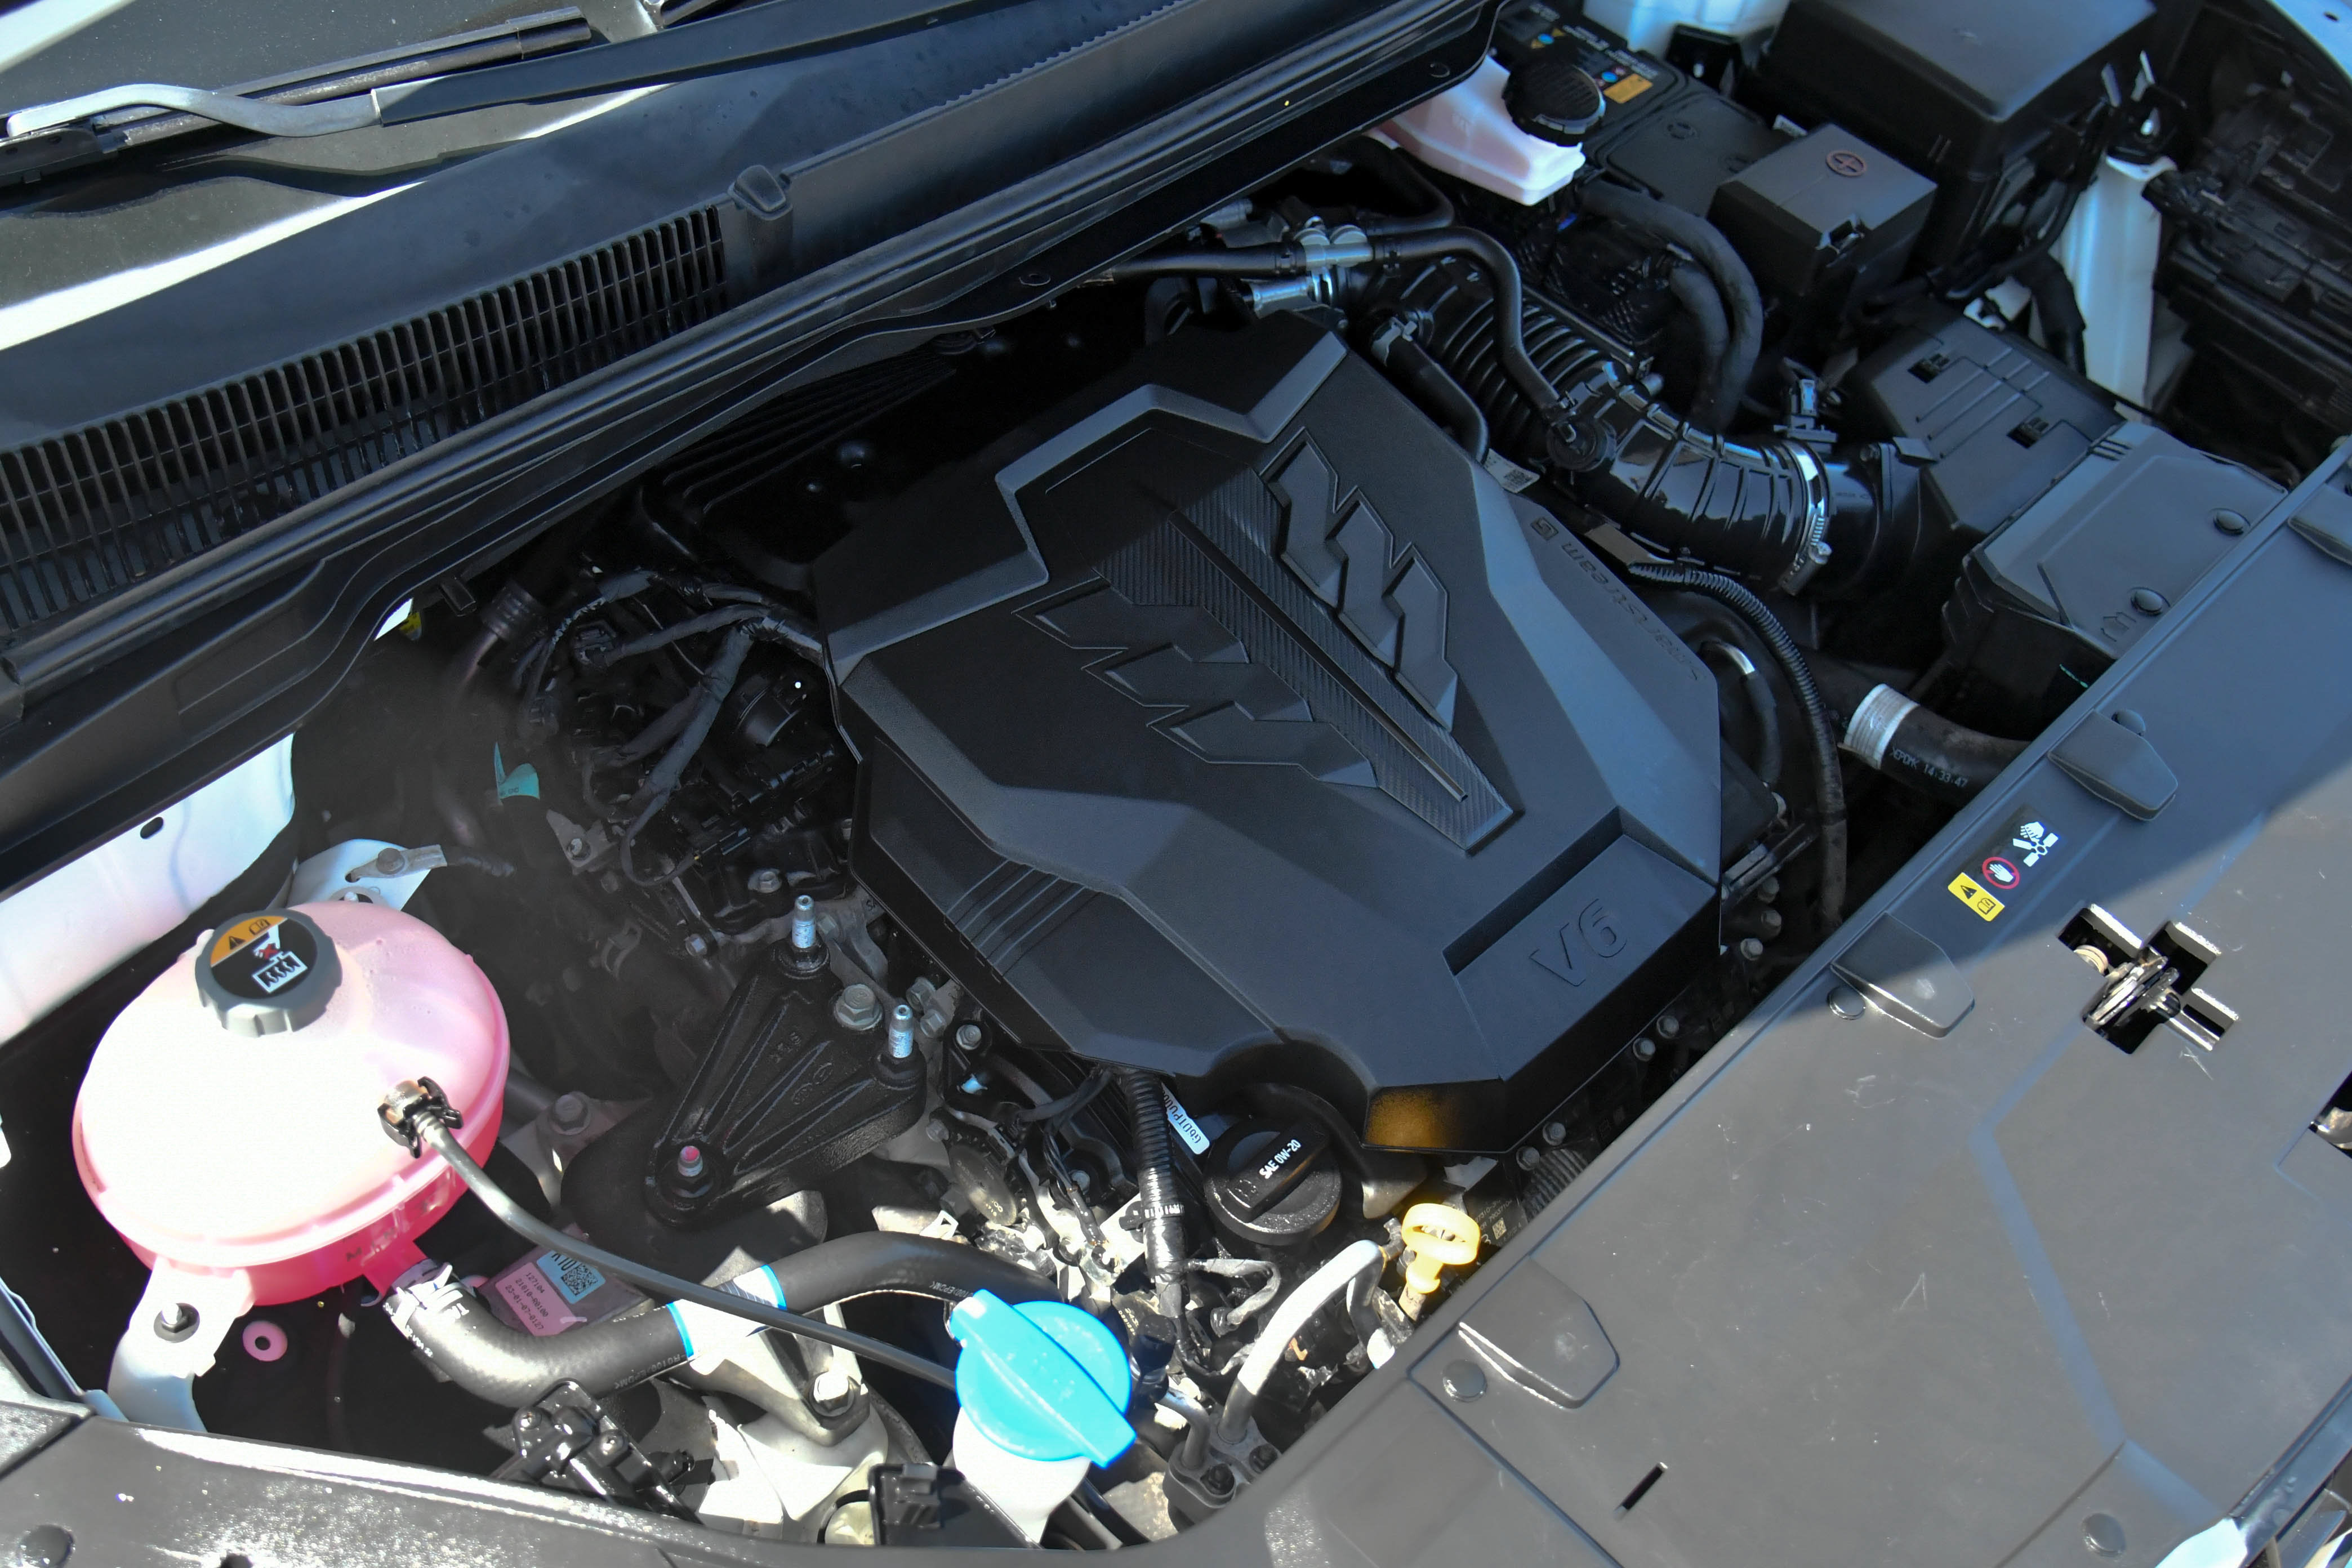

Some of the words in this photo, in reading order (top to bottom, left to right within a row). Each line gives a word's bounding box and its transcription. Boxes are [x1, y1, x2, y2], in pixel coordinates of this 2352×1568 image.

[1529, 899, 1627, 986] V6
[1259, 1160, 1279, 1179] SAE
[1274, 1138, 1303, 1164] 0W-20
[515, 1278, 550, 1318] 21810-R0100
[525, 1272, 546, 1294] 127104
[505, 1284, 545, 1331] 23-01-07-0127
